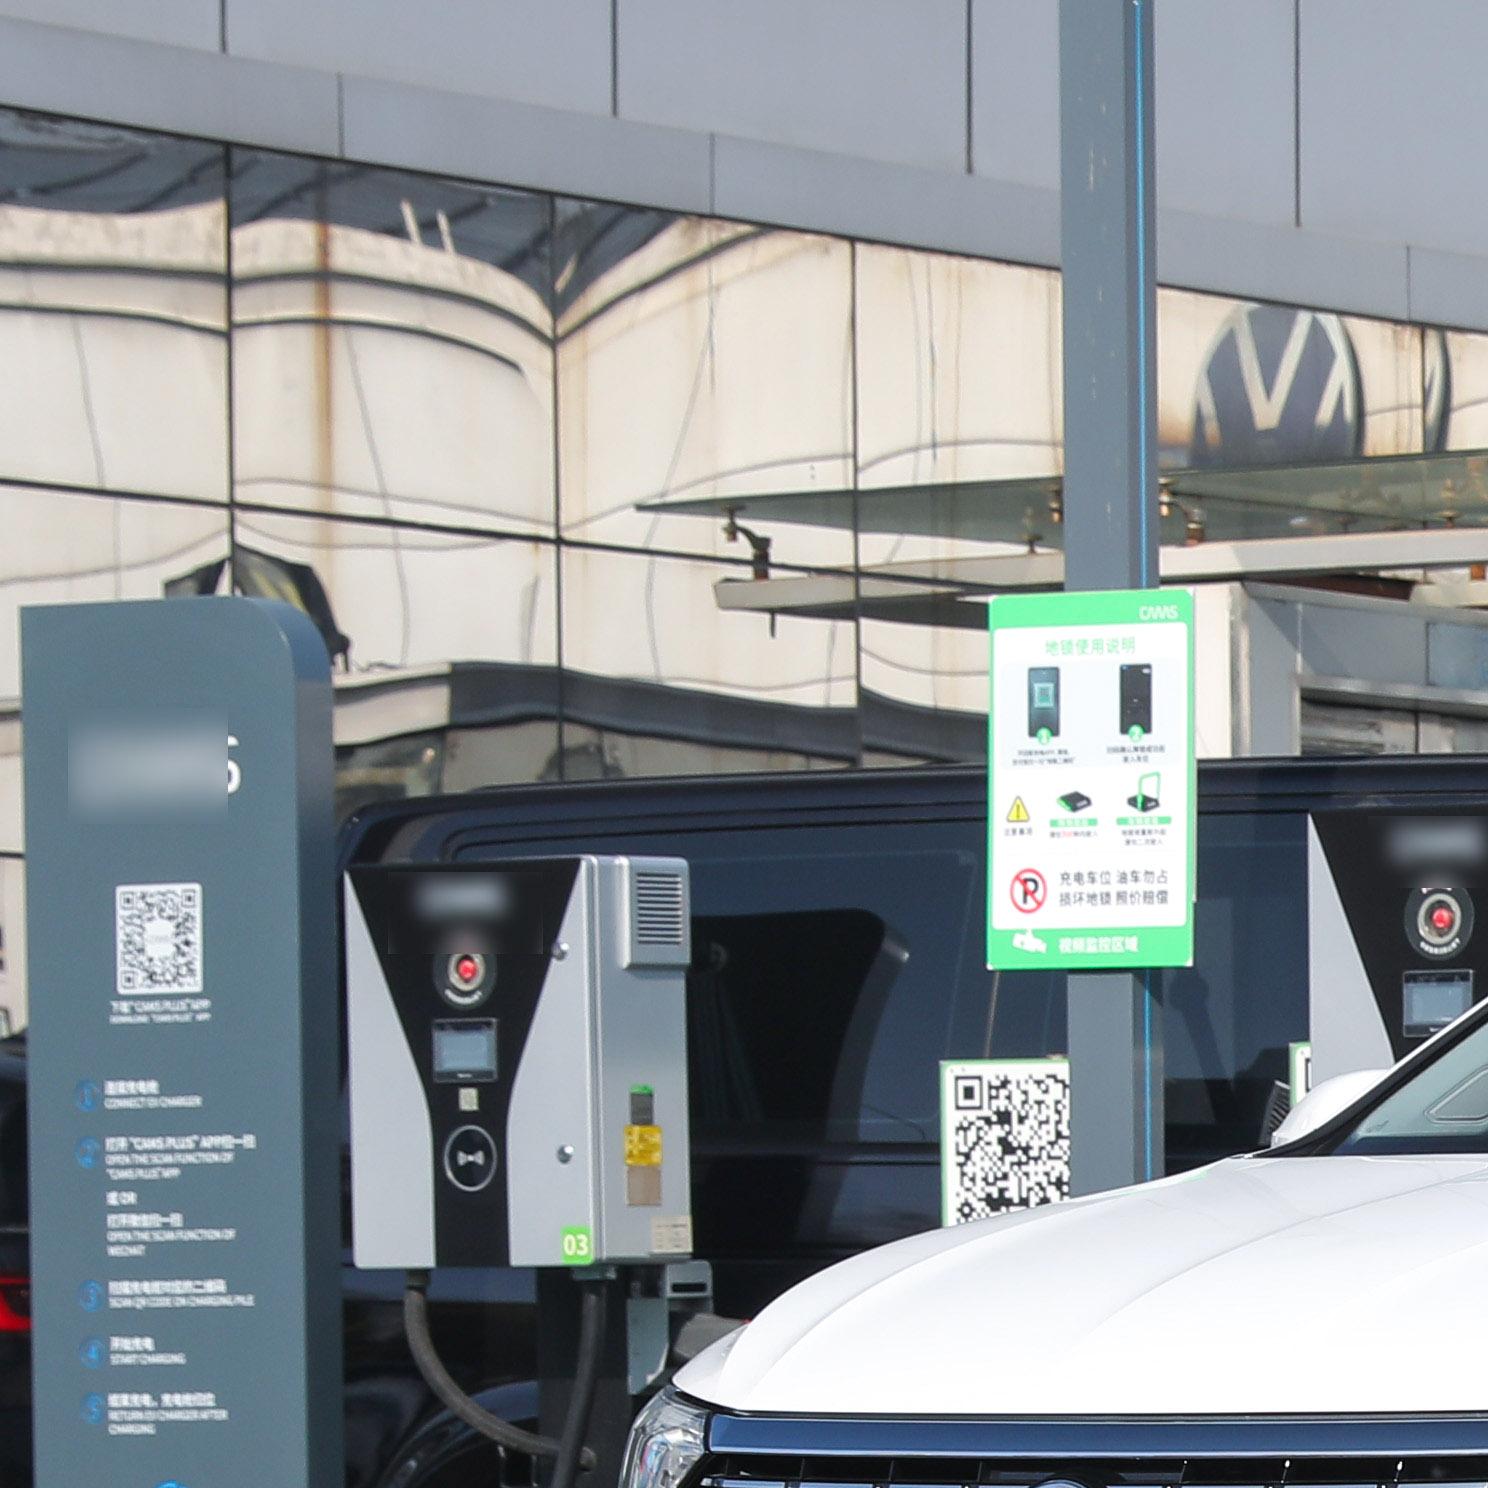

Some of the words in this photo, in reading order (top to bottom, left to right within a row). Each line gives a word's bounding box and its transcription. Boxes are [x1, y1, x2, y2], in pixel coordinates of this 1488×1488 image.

[1045, 636, 1135, 656] 地锁使用说明
[1060, 870, 1111, 886] 充电车位
[1116, 869, 1168, 885] 油车勿占
[1115, 890, 1168, 905] 照价赔偿
[563, 1234, 588, 1256] 03
